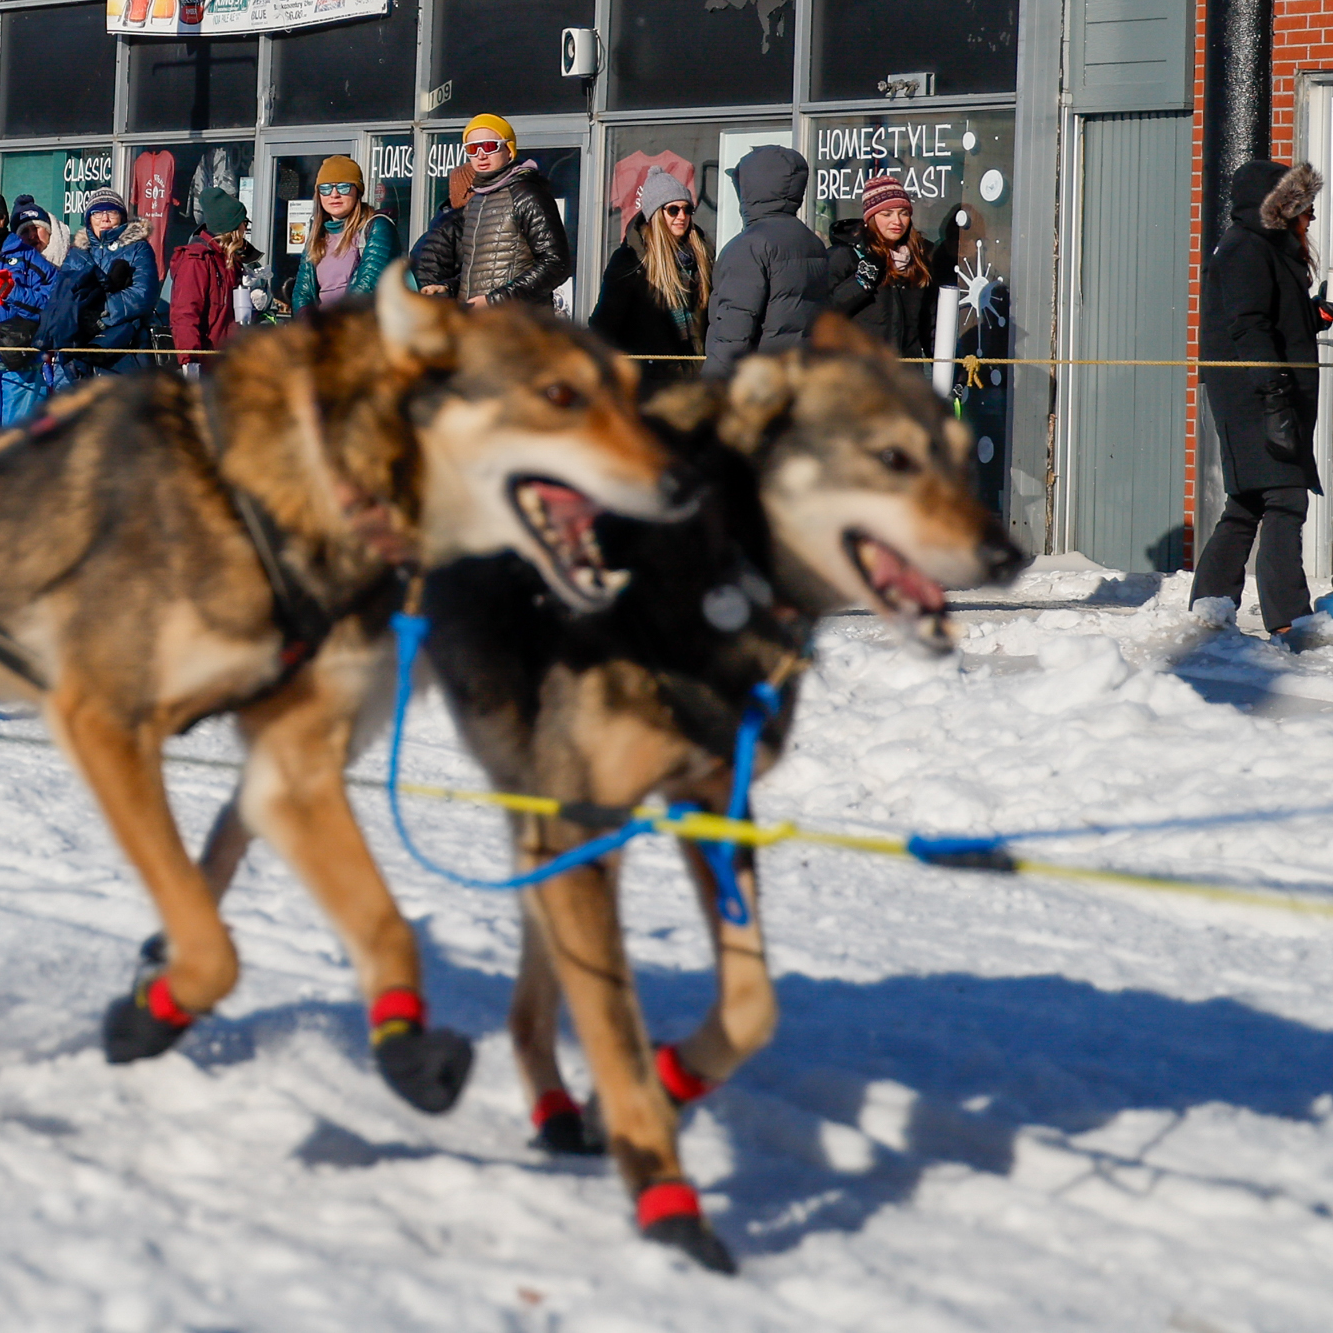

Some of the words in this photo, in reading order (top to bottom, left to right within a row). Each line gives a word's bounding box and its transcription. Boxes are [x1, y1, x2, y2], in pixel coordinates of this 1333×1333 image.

[251, 9, 267, 20] BLUE
[429, 84, 452, 109] 109
[818, 123, 952, 161] HOMESTYLE
[64, 157, 112, 182] CLASSIC
[371, 145, 414, 179] FLOATS
[817, 166, 952, 200] BREAAST
